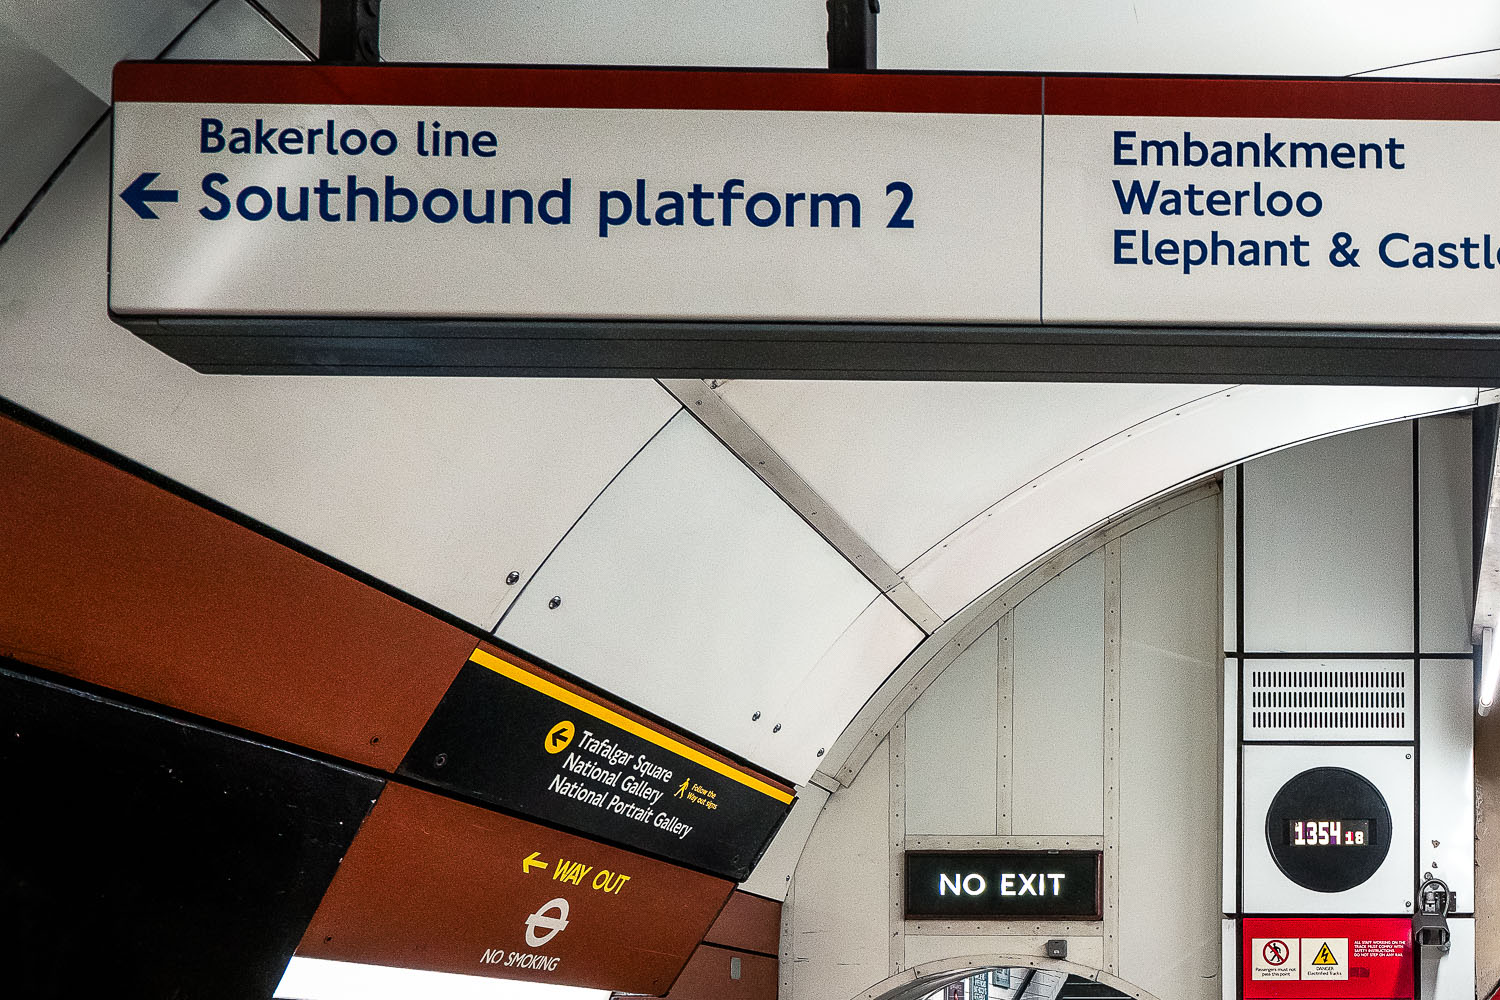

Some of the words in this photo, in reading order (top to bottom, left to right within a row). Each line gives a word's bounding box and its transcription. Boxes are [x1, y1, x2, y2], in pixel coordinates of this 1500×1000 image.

[200, 118, 398, 156] Bakerloo
[416, 121, 498, 157] line
[1112, 130, 1405, 169] Embankment
[198, 172, 571, 224] Southbound
[599, 178, 861, 238] platform
[886, 182, 915, 229] 2
[1112, 180, 1323, 217] Waterloo
[1113, 229, 1310, 274] Elephant
[1329, 232, 1360, 268] &
[578, 730, 634, 766] Trafalgar
[633, 755, 673, 782] Square
[562, 752, 622, 787] National
[620, 776, 664, 805] Gallery
[687, 792, 698, 803] Way
[692, 784, 708, 795] Follow
[707, 791, 716, 799] the
[548, 774, 609, 808] National
[606, 795, 653, 823] Portrait
[654, 812, 693, 839] Gallery
[1294, 821, 1341, 845] 1354
[1345, 831, 1364, 844] 18
[553, 859, 593, 885] WAY
[592, 870, 631, 894] OUT
[940, 874, 986, 895] NO
[1001, 874, 1065, 895] EXIT
[480, 949, 504, 964] NO
[504, 952, 560, 971] SMOKING
